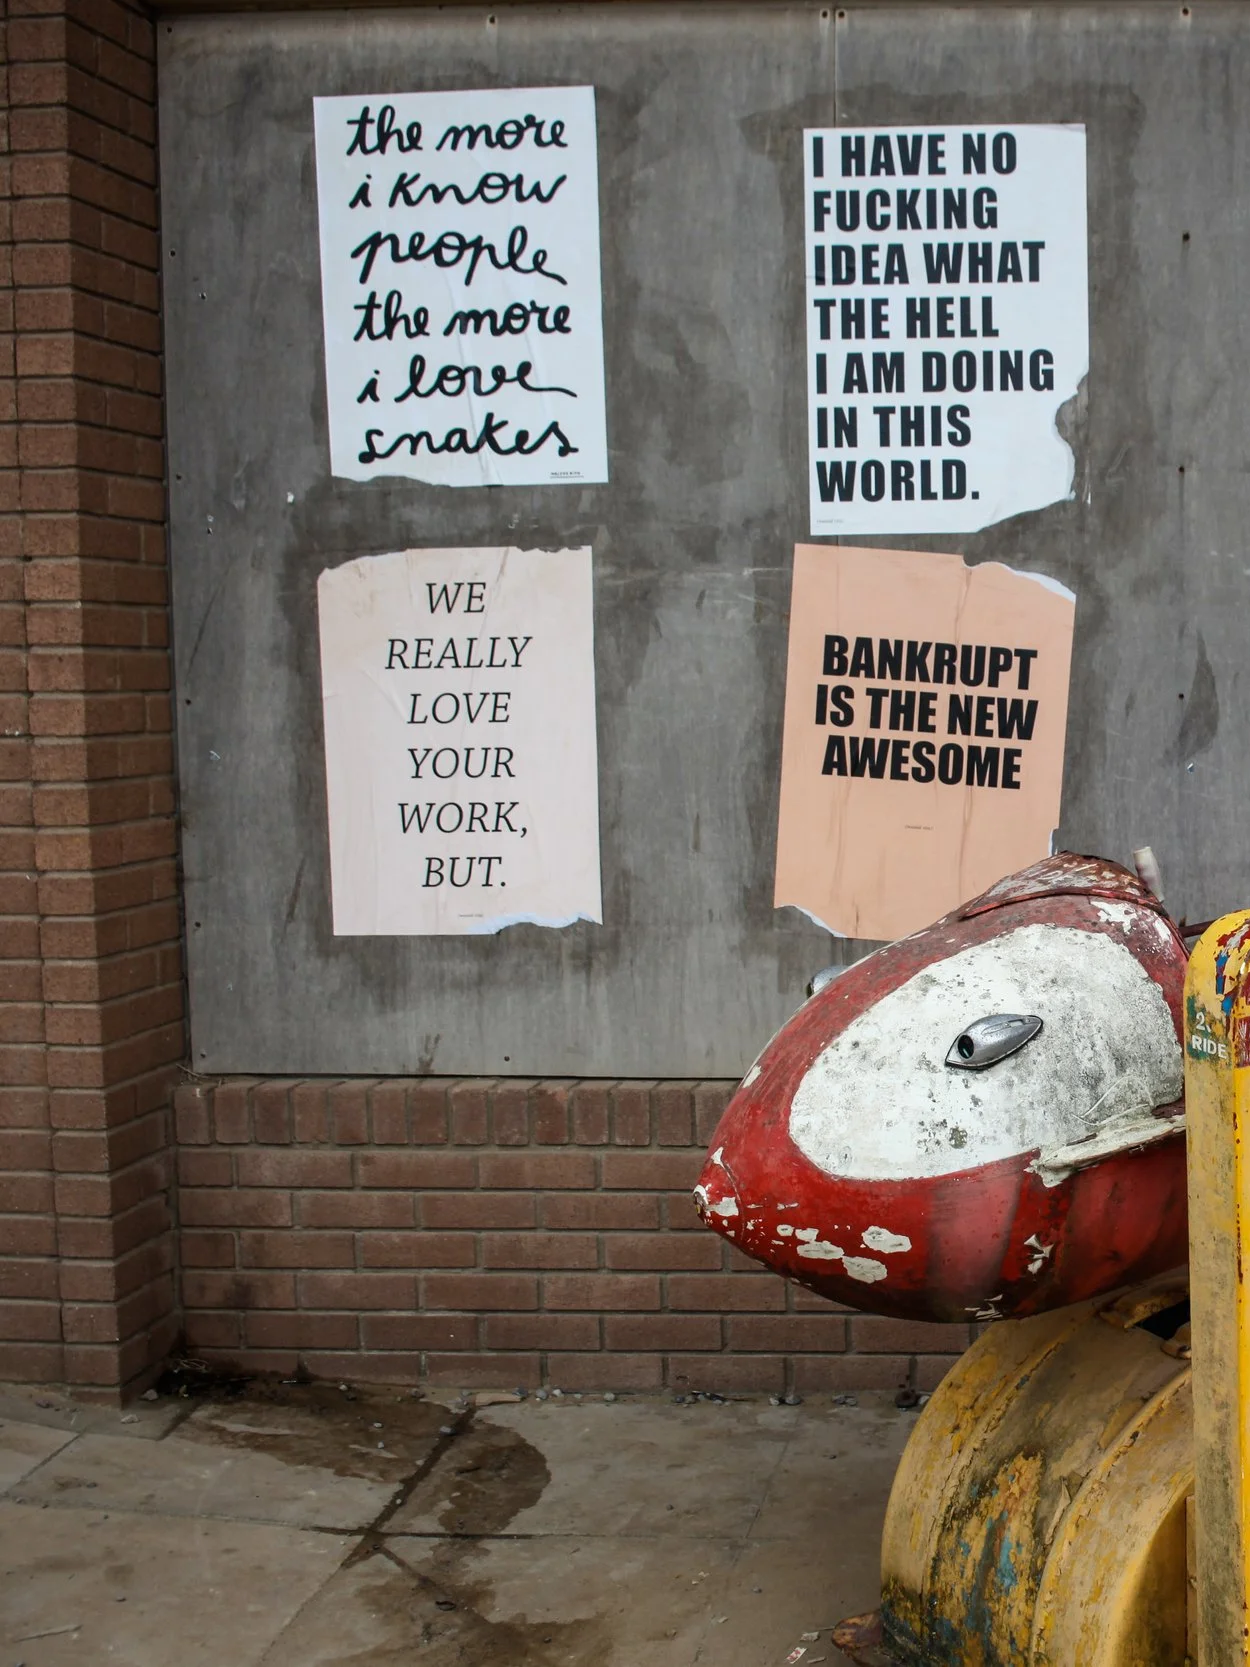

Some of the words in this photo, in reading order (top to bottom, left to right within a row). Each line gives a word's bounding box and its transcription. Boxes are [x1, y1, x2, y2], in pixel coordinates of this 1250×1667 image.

[346, 104, 423, 156] the
[435, 114, 568, 151] more
[812, 136, 824, 178] I
[841, 134, 946, 177] HAVE
[962, 132, 1017, 175] NO
[348, 174, 372, 209] i
[813, 187, 998, 232] FUCKING
[350, 225, 568, 287] people
[814, 243, 909, 286] IDEA
[922, 241, 1045, 284] WHAT
[353, 289, 430, 342] the
[442, 300, 572, 337] more
[813, 298, 890, 340] THE
[906, 296, 999, 339] HELL
[356, 369, 380, 404] i
[394, 354, 578, 403] love
[816, 353, 827, 394] I
[842, 352, 905, 394] AM
[922, 349, 1054, 393] DOING
[358, 412, 579, 464] snakes
[817, 406, 858, 449] IN
[873, 404, 971, 447] THIS
[816, 459, 980, 503] WORLD.
[426, 582, 486, 614] WE
[385, 636, 533, 670] REALLY
[822, 634, 1038, 690] BANKRUPT
[407, 692, 511, 724] LOVE
[815, 683, 855, 728] IS
[865, 687, 938, 734] THE
[947, 693, 1039, 741] NEW
[407, 747, 516, 779] YOUR
[821, 734, 1023, 790] AWESOME
[398, 801, 527, 838] WORK,
[422, 856, 506, 888] BUT.
[1191, 1034, 1229, 1060] RIDE
